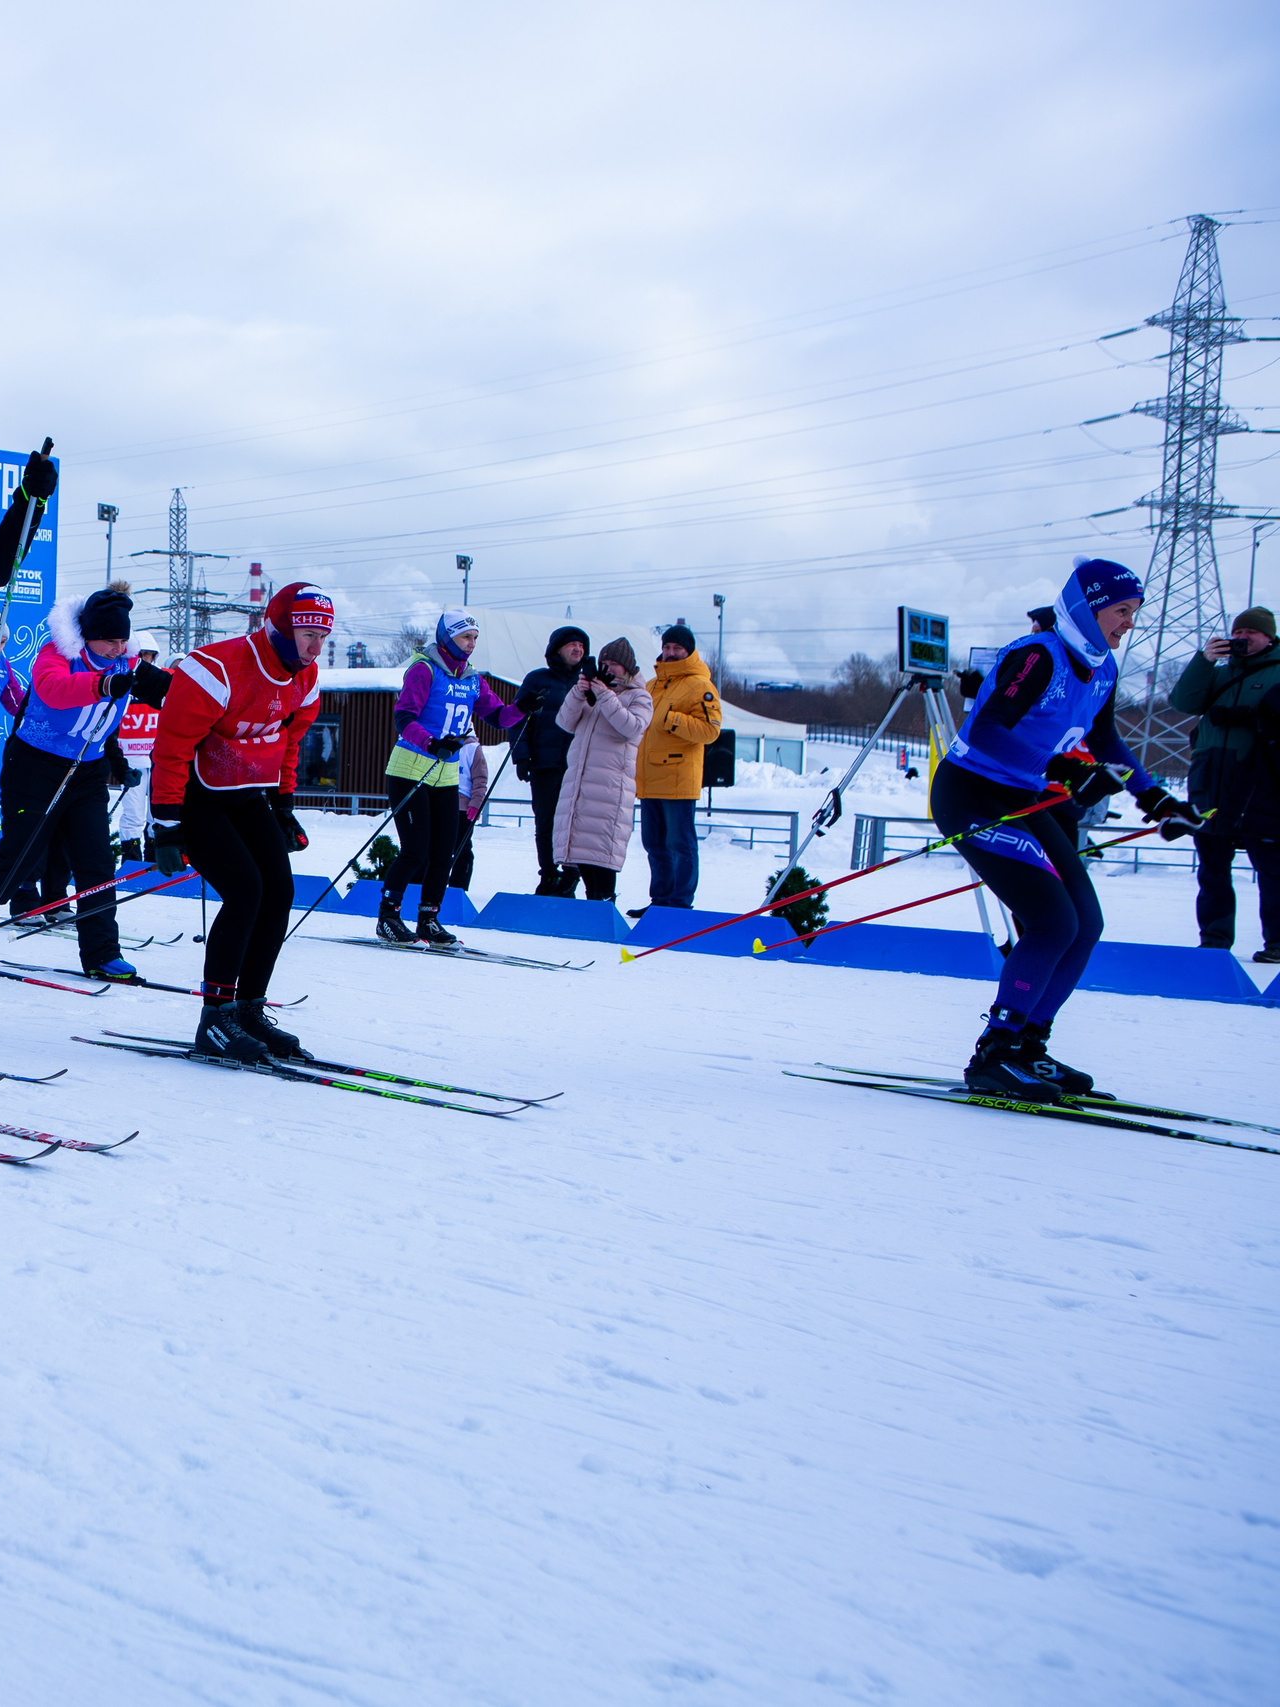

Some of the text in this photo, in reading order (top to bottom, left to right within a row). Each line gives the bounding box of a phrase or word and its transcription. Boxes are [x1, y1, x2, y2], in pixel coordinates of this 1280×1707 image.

[1004, 652, 1040, 698] SPINE
[67, 701, 117, 742] 10
[440, 702, 469, 740] 13
[966, 1095, 1042, 1114] FISCHER
